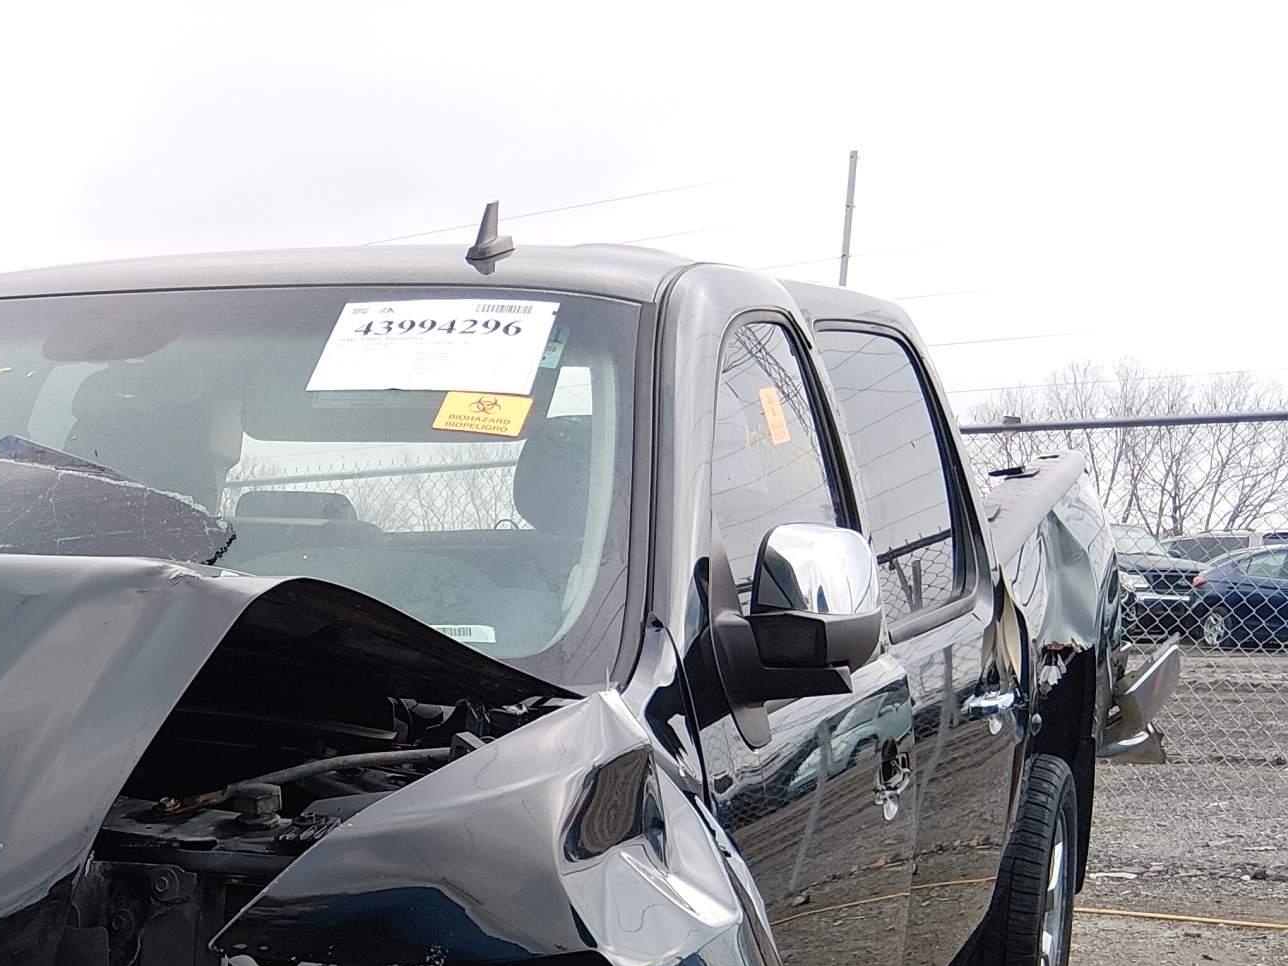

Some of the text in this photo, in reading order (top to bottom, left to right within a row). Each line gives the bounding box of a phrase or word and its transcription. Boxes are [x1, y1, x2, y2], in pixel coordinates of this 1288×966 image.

[354, 318, 523, 336] 43994296
[449, 413, 511, 425] BIOHAZARD
[445, 421, 508, 433] BIOPELIGRO
